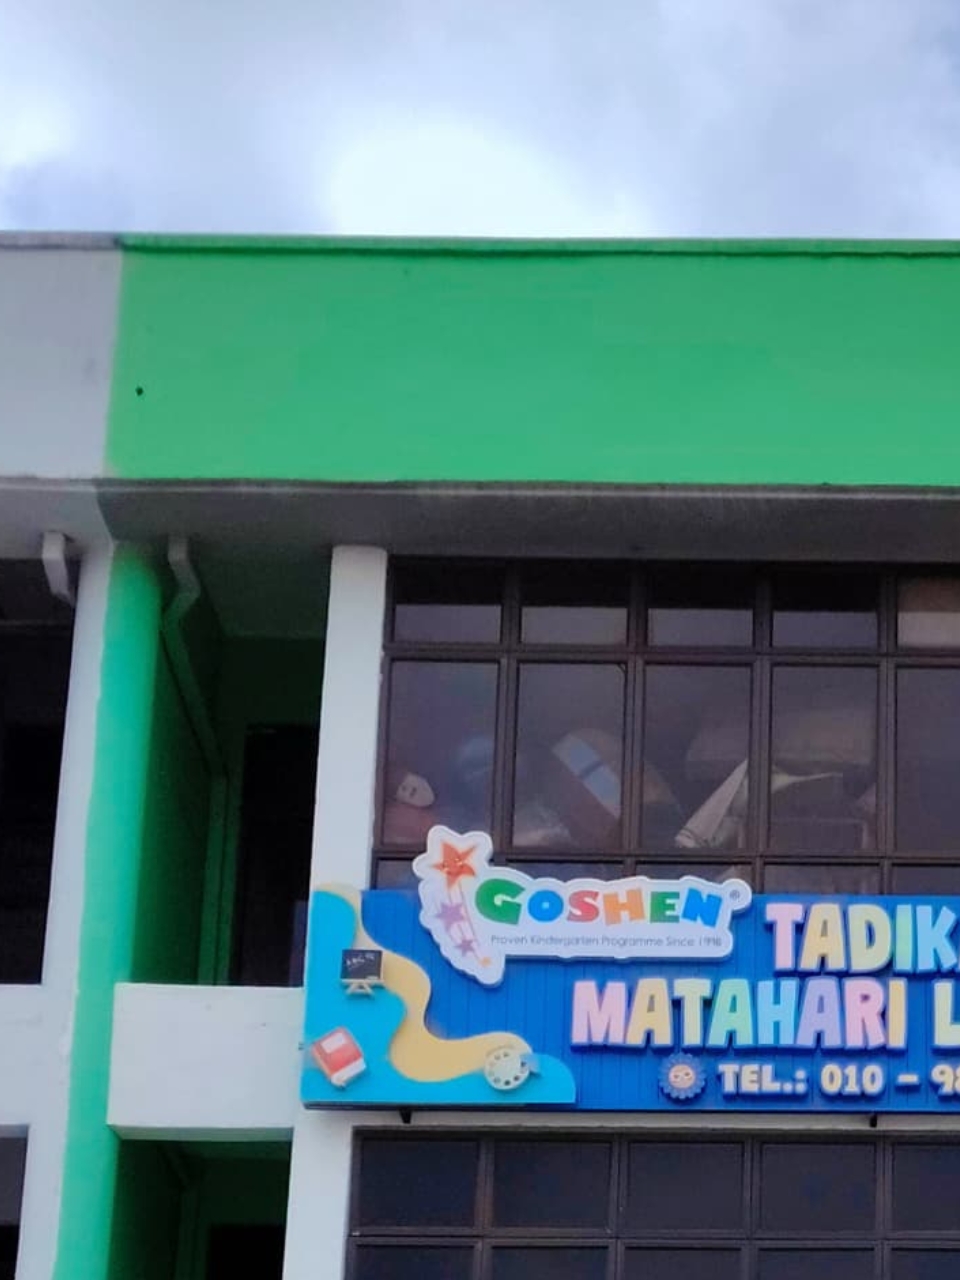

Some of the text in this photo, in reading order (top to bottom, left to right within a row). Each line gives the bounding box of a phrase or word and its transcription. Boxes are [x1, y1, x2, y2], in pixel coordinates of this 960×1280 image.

[474, 878, 724, 926] GOSHEN
[490, 934, 527, 946] Proven
[530, 934, 598, 948] Kindergarten
[601, 935, 662, 949] Programme
[666, 936, 694, 947] Since
[571, 977, 908, 1049] MATAHARI
[820, 1062, 885, 1096] 010
